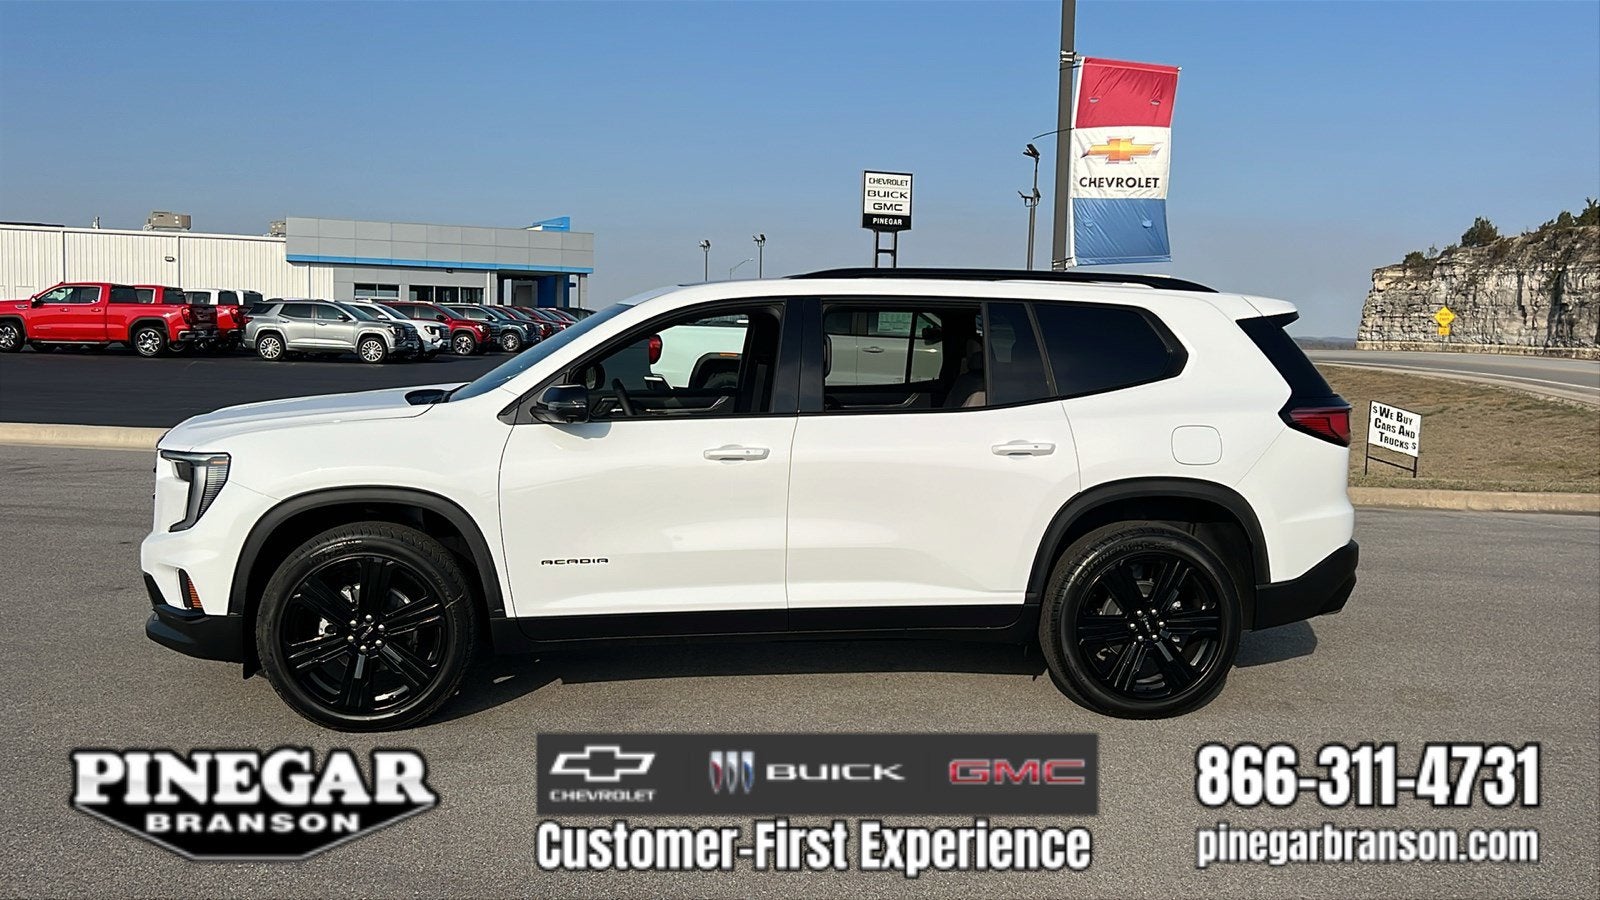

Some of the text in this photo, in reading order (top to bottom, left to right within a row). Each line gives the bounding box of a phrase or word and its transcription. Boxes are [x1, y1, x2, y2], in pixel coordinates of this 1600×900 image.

[868, 177, 908, 187] CHEVROLET
[1079, 176, 1160, 189] CHEVROLET
[867, 189, 908, 199] BUICK
[872, 202, 903, 212] GMC
[872, 217, 903, 226] PINEGAR
[1379, 431, 1409, 450] TRUCKS
[541, 557, 609, 565] ACADIA
